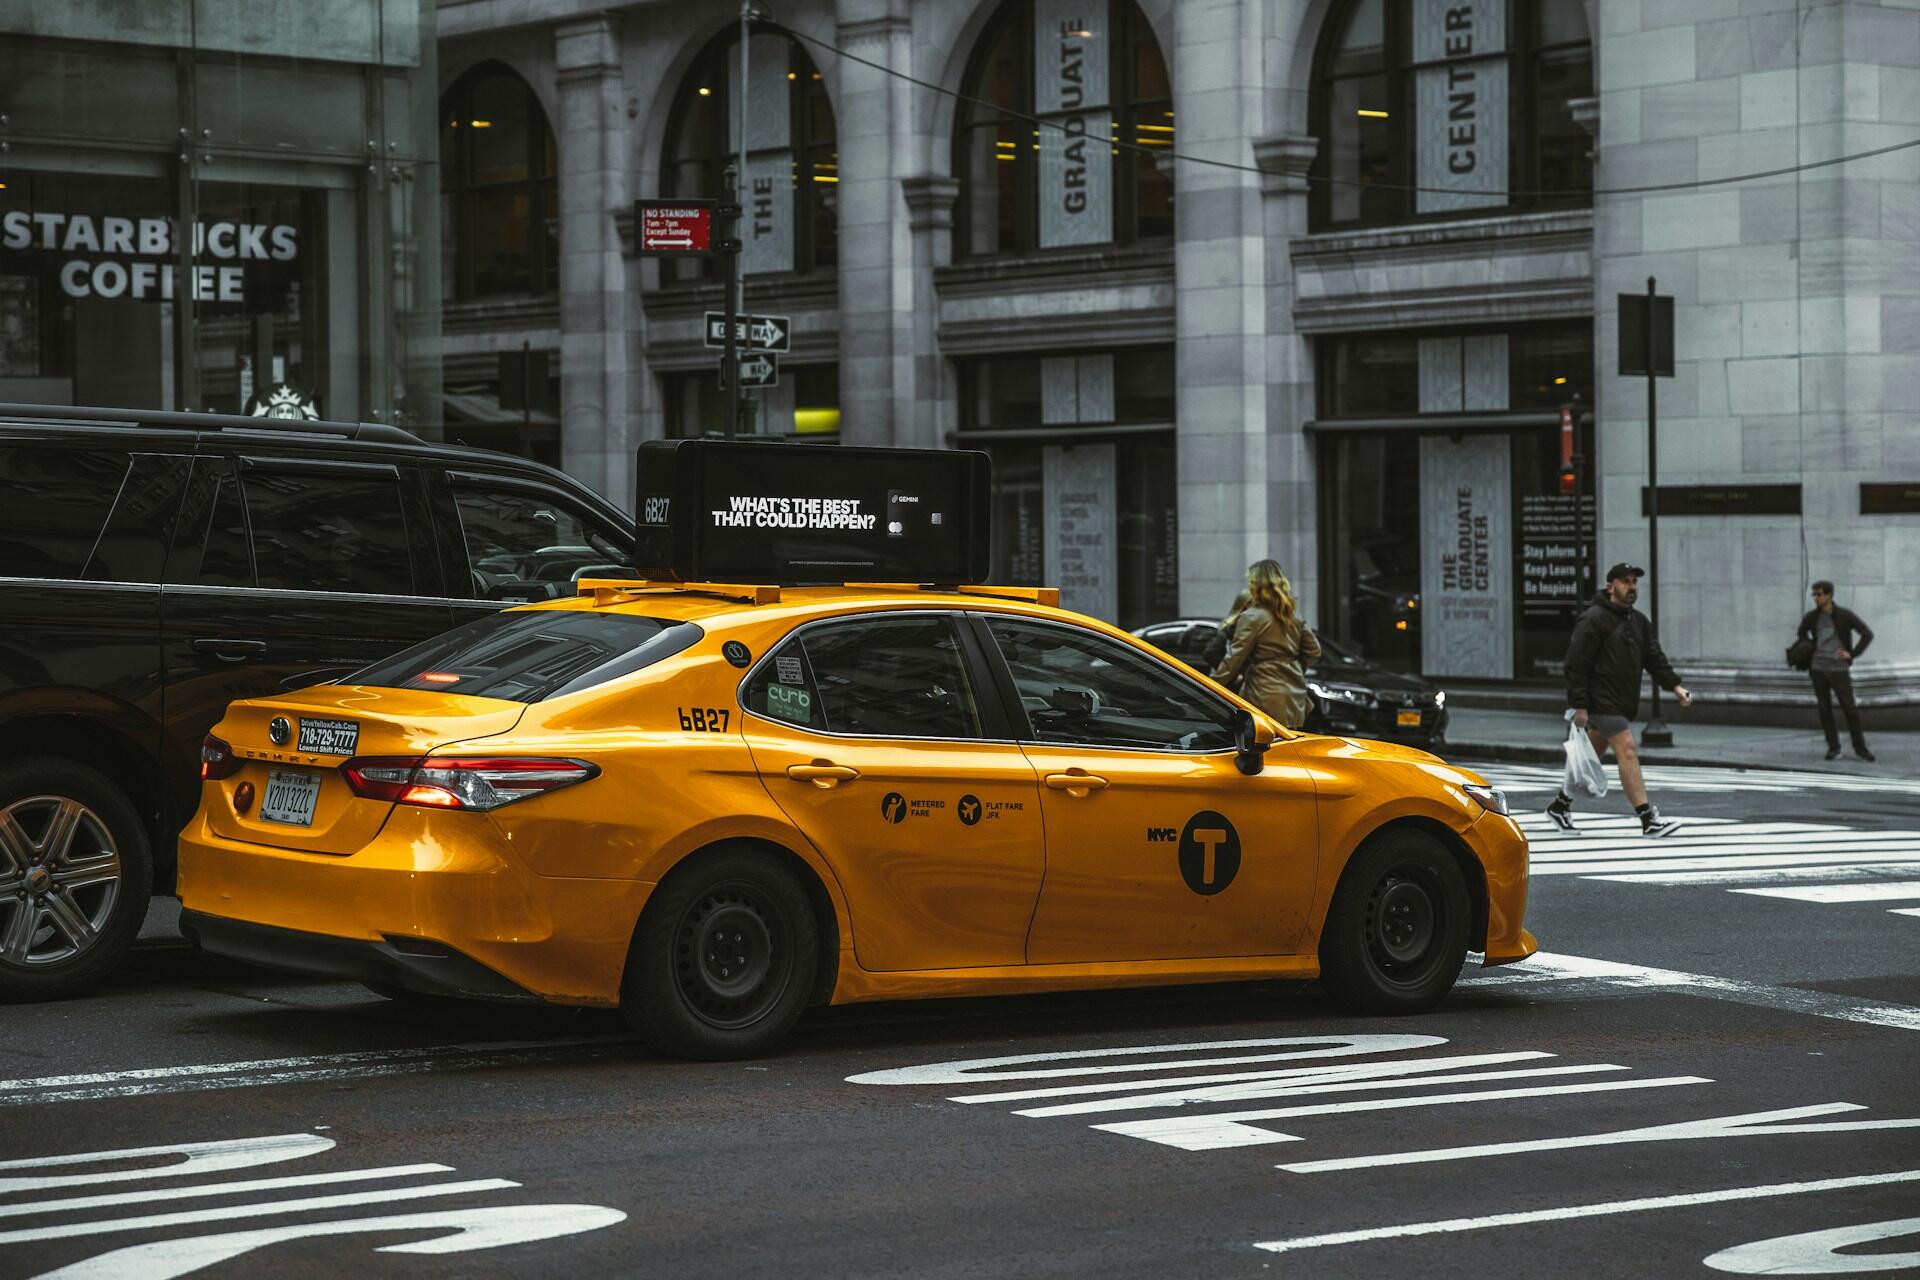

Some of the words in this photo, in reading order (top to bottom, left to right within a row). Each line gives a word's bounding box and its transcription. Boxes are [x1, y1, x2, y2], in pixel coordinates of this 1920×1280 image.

[1445, 6, 1476, 174] CENTER
[1061, 18, 1087, 214] GRADUATE
[646, 209, 658, 218] NO
[660, 209, 700, 218] STANDING
[753, 177, 773, 240] THE
[646, 228, 667, 236] Except
[668, 228, 691, 237] Sunday
[718, 325, 742, 339] OE
[752, 327, 777, 342] WAY
[645, 497, 670, 523] 6B27
[730, 496, 790, 513] WHAT'S
[791, 498, 821, 513] THE
[823, 499, 860, 515] BEST
[711, 511, 754, 526] THAT
[755, 512, 807, 528] COULD
[808, 513, 876, 529] HAPPEN?
[1458, 488, 1472, 591] GRADUATE
[1475, 516, 1489, 591] CENTER
[1524, 544, 1544, 560] Stay
[1546, 544, 1588, 558] Informd
[1443, 554, 1457, 591] THE
[1524, 563, 1547, 579] Keep
[1549, 563, 1590, 579] Learng
[1524, 581, 1537, 594] Be
[1539, 581, 1577, 597] Inspired
[768, 686, 810, 707] curb
[301, 719, 358, 730] DriveYellowCab.Com
[300, 727, 357, 747] 718-729-7777
[246, 750, 319, 762] CAMRY
[299, 744, 318, 752] Lowest
[334, 747, 353, 755] Prices
[266, 784, 312, 814] Y201322C
[910, 800, 945, 808] METERED
[985, 803, 1003, 811] FLAT
[1005, 803, 1024, 811] FARE
[1147, 828, 1177, 842] NYC
[1193, 829, 1227, 884] T
[844, 1033, 1920, 1174] ONLY
